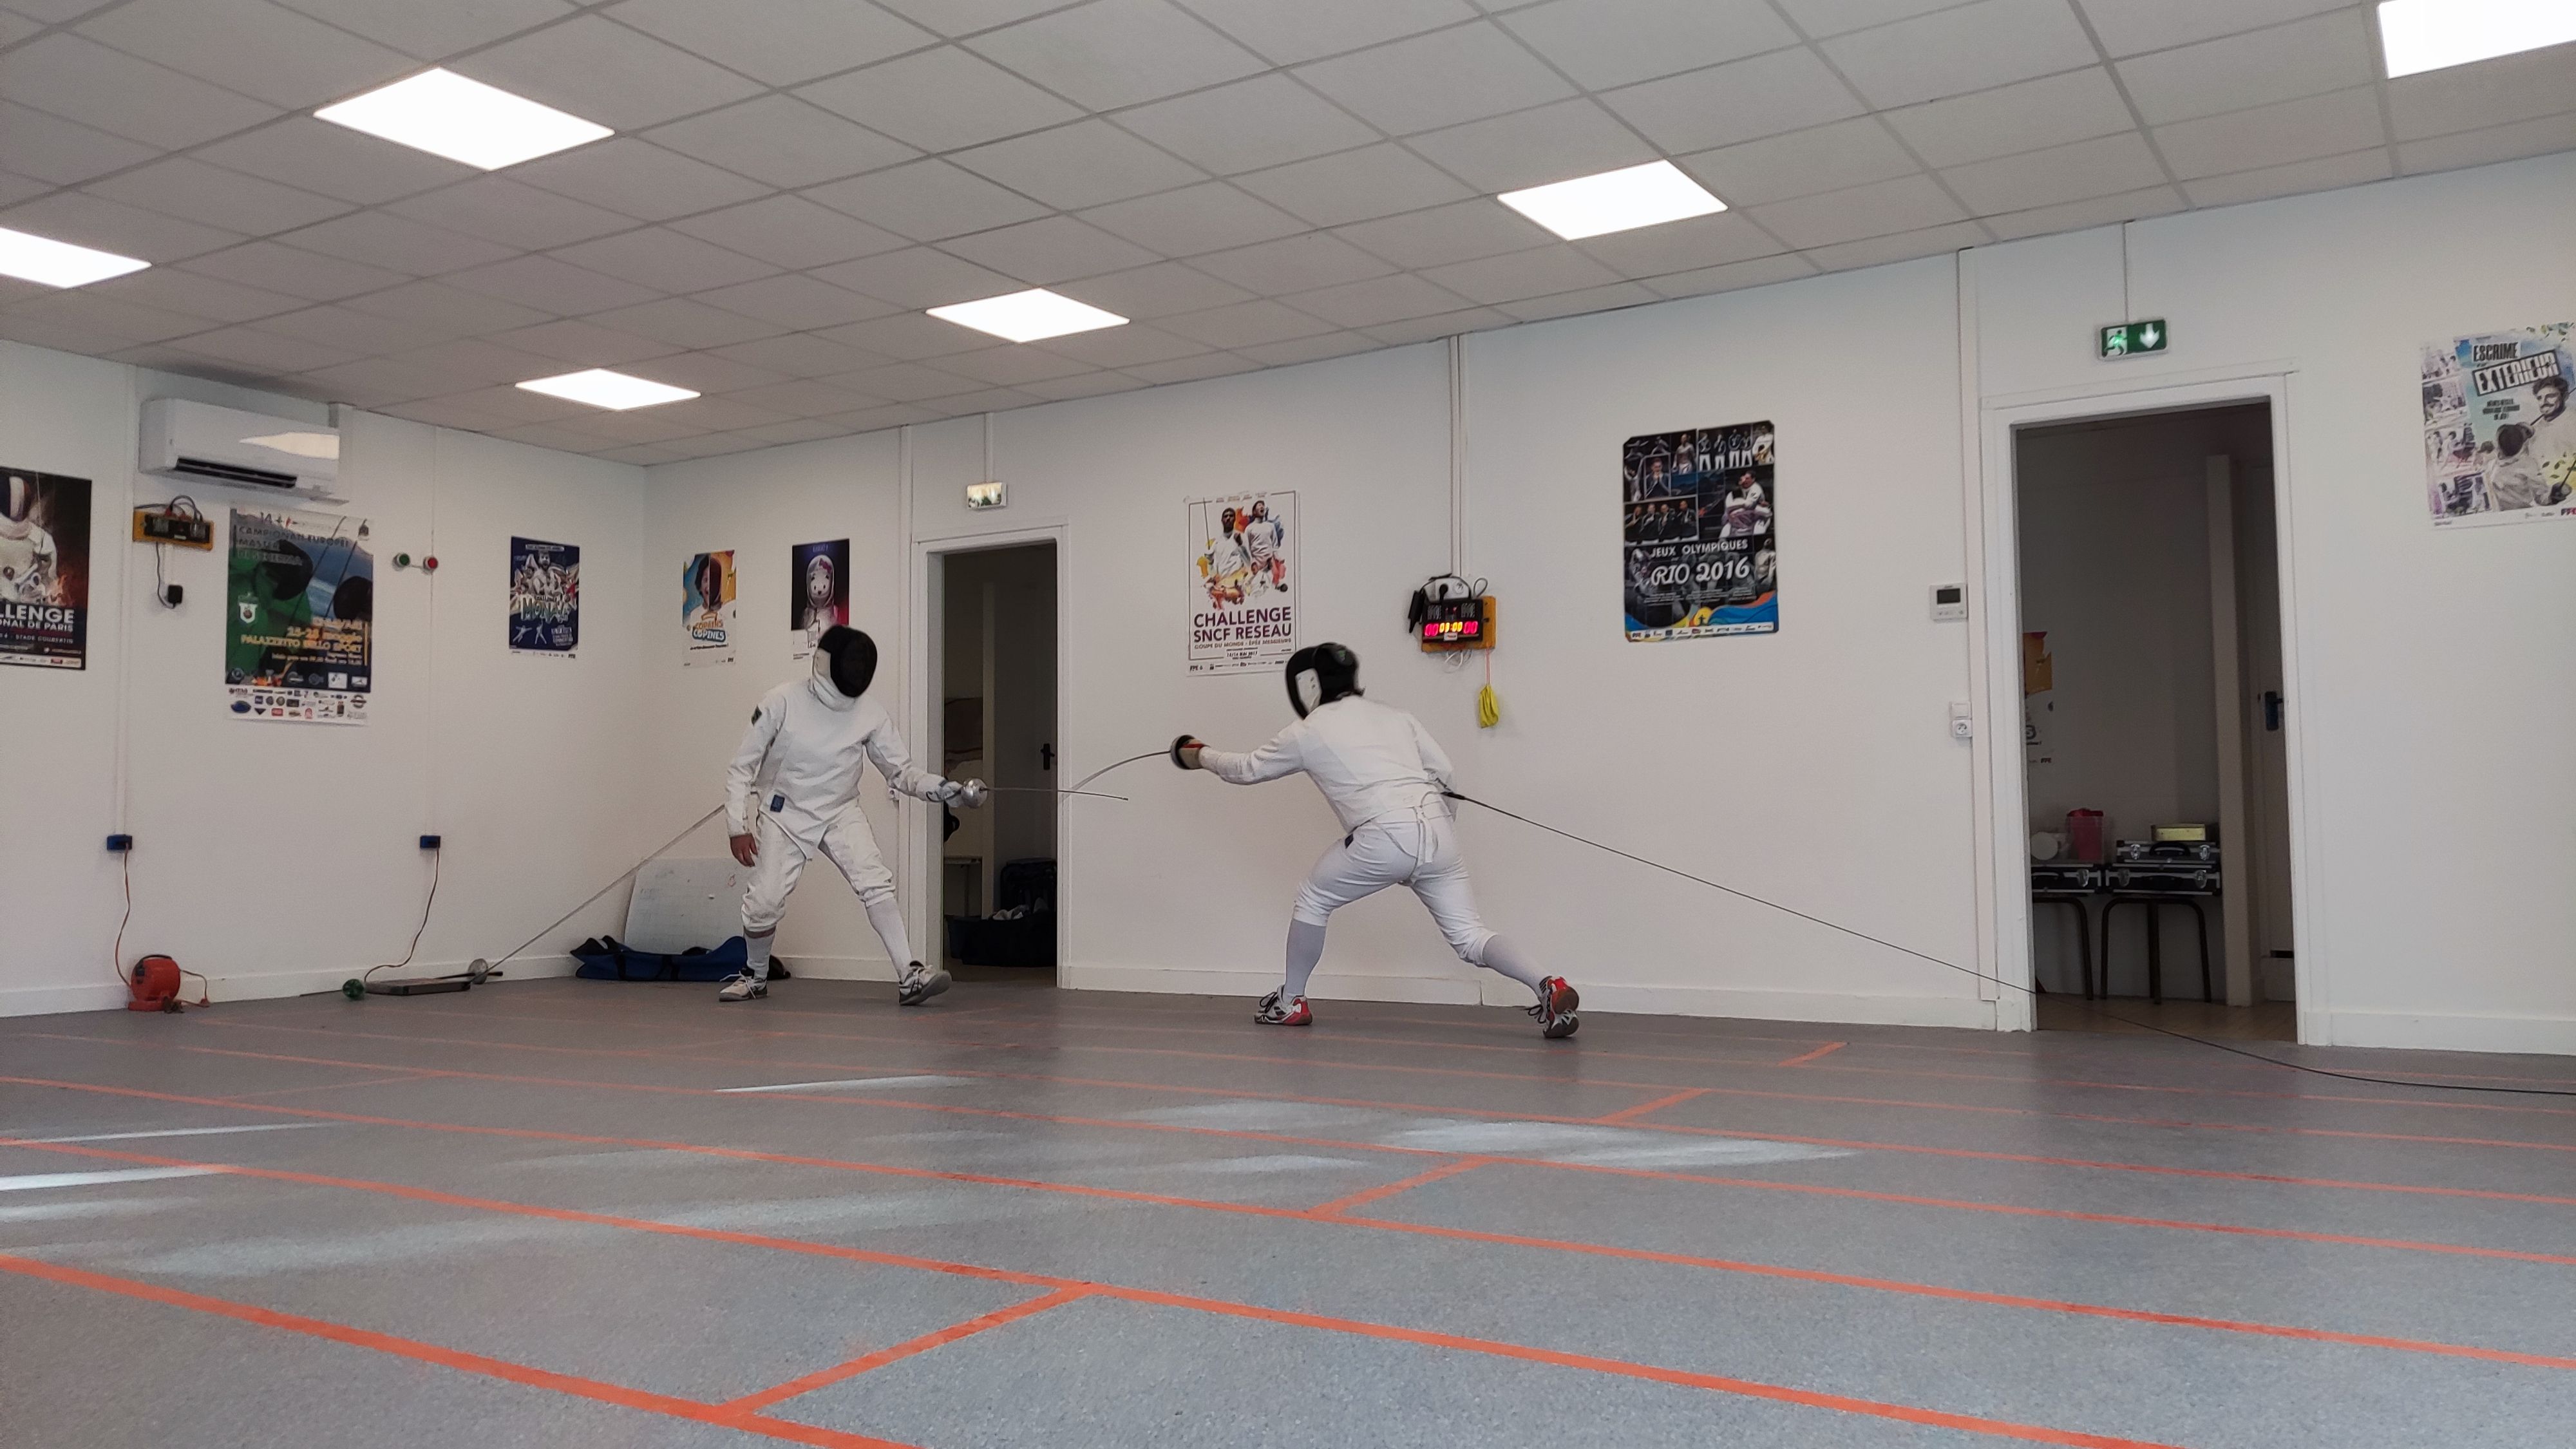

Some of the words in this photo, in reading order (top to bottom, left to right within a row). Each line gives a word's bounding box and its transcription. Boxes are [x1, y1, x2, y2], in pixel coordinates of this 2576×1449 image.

[2473, 342, 2518, 362] ESCRIME
[2474, 352, 2560, 395] EXTERIEUR
[1651, 546, 1676, 558] JEUX
[1681, 539, 1748, 554] OLYMPIQUES
[1651, 563, 1690, 586] RIO
[1696, 556, 1750, 582] 2016
[28, 621, 41, 629] DE
[44, 622, 73, 632] PARIS
[1194, 607, 1291, 627] CHALLENGE
[693, 629, 725, 641] COPINES
[1193, 628, 1231, 643] SNCF
[1236, 623, 1292, 639] RESEAU
[1425, 623, 1439, 638] 00
[1463, 621, 1479, 634] 00
